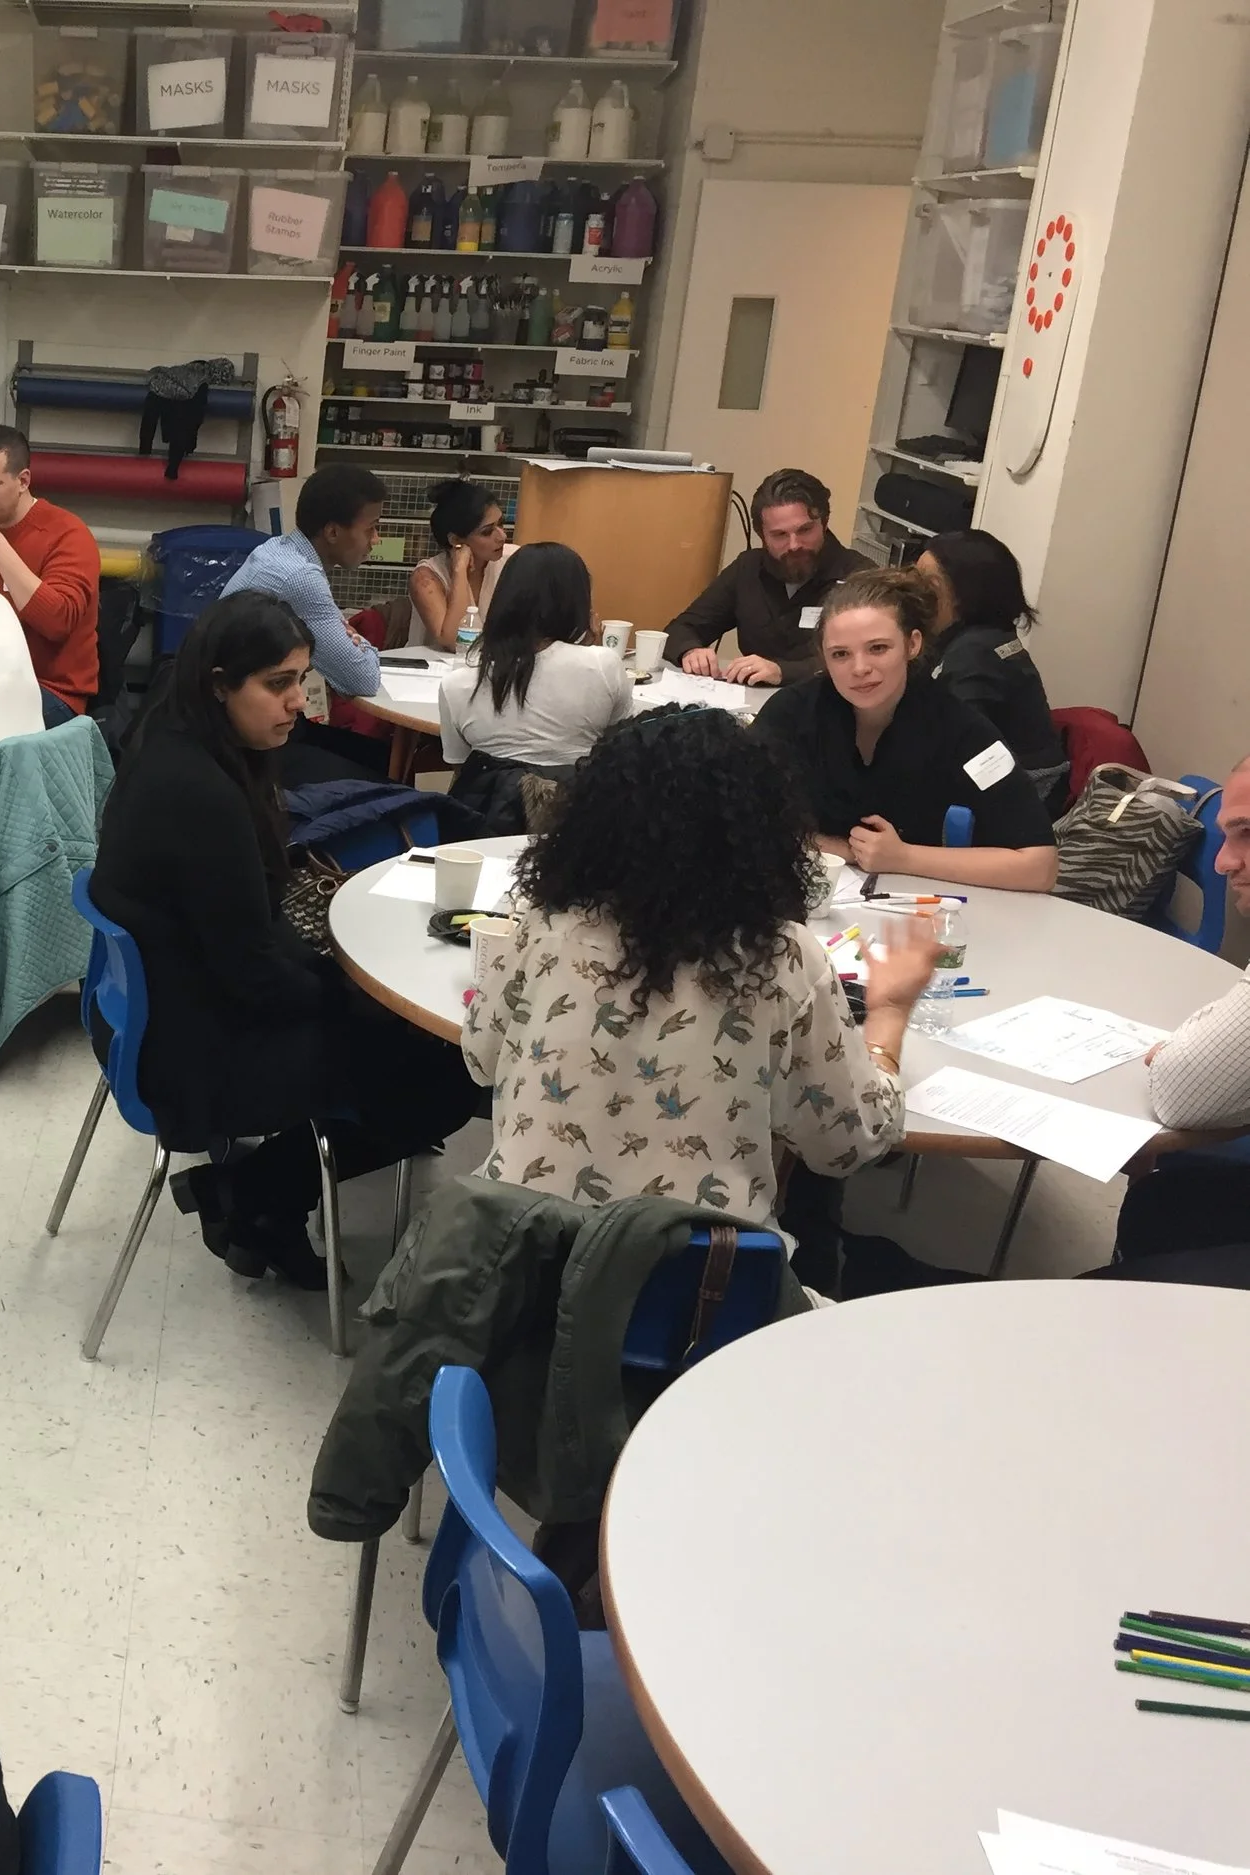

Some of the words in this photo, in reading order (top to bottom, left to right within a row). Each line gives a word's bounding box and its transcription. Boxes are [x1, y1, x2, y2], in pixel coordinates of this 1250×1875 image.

[159, 79, 215, 97] MASKS
[266, 79, 321, 96] MASKS
[47, 208, 104, 221] Watercolor
[268, 211, 303, 226] Rubber
[265, 223, 301, 240] Stamps
[590, 263, 623, 275] Acrylic
[352, 345, 380, 358] Finger
[383, 346, 406, 358] Paint
[569, 355, 598, 367] Fabric
[600, 357, 615, 367] Ink
[466, 404, 482, 415] Ink
